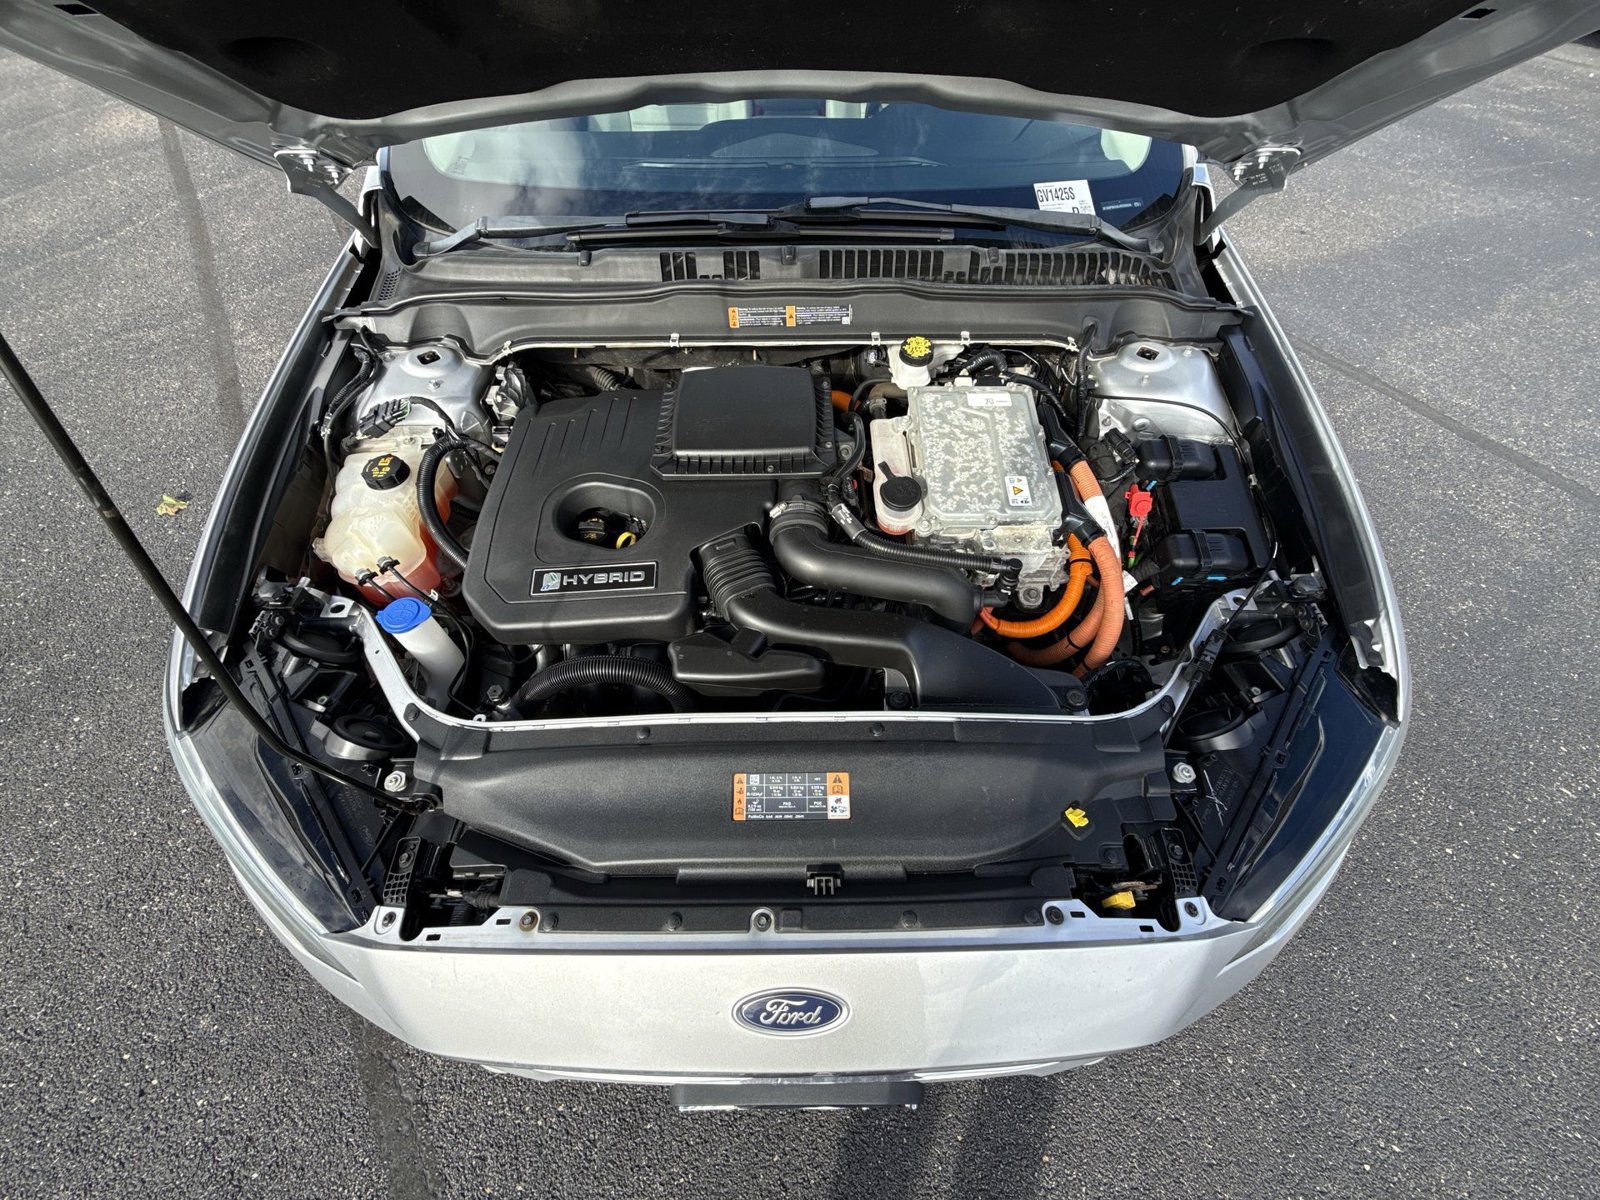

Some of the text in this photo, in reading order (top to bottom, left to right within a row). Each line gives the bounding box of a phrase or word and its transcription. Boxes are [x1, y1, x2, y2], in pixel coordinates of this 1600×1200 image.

[1037, 187, 1075, 202] GV1425S
[562, 570, 646, 586] HYBRID
[759, 998, 823, 1025] Ford
